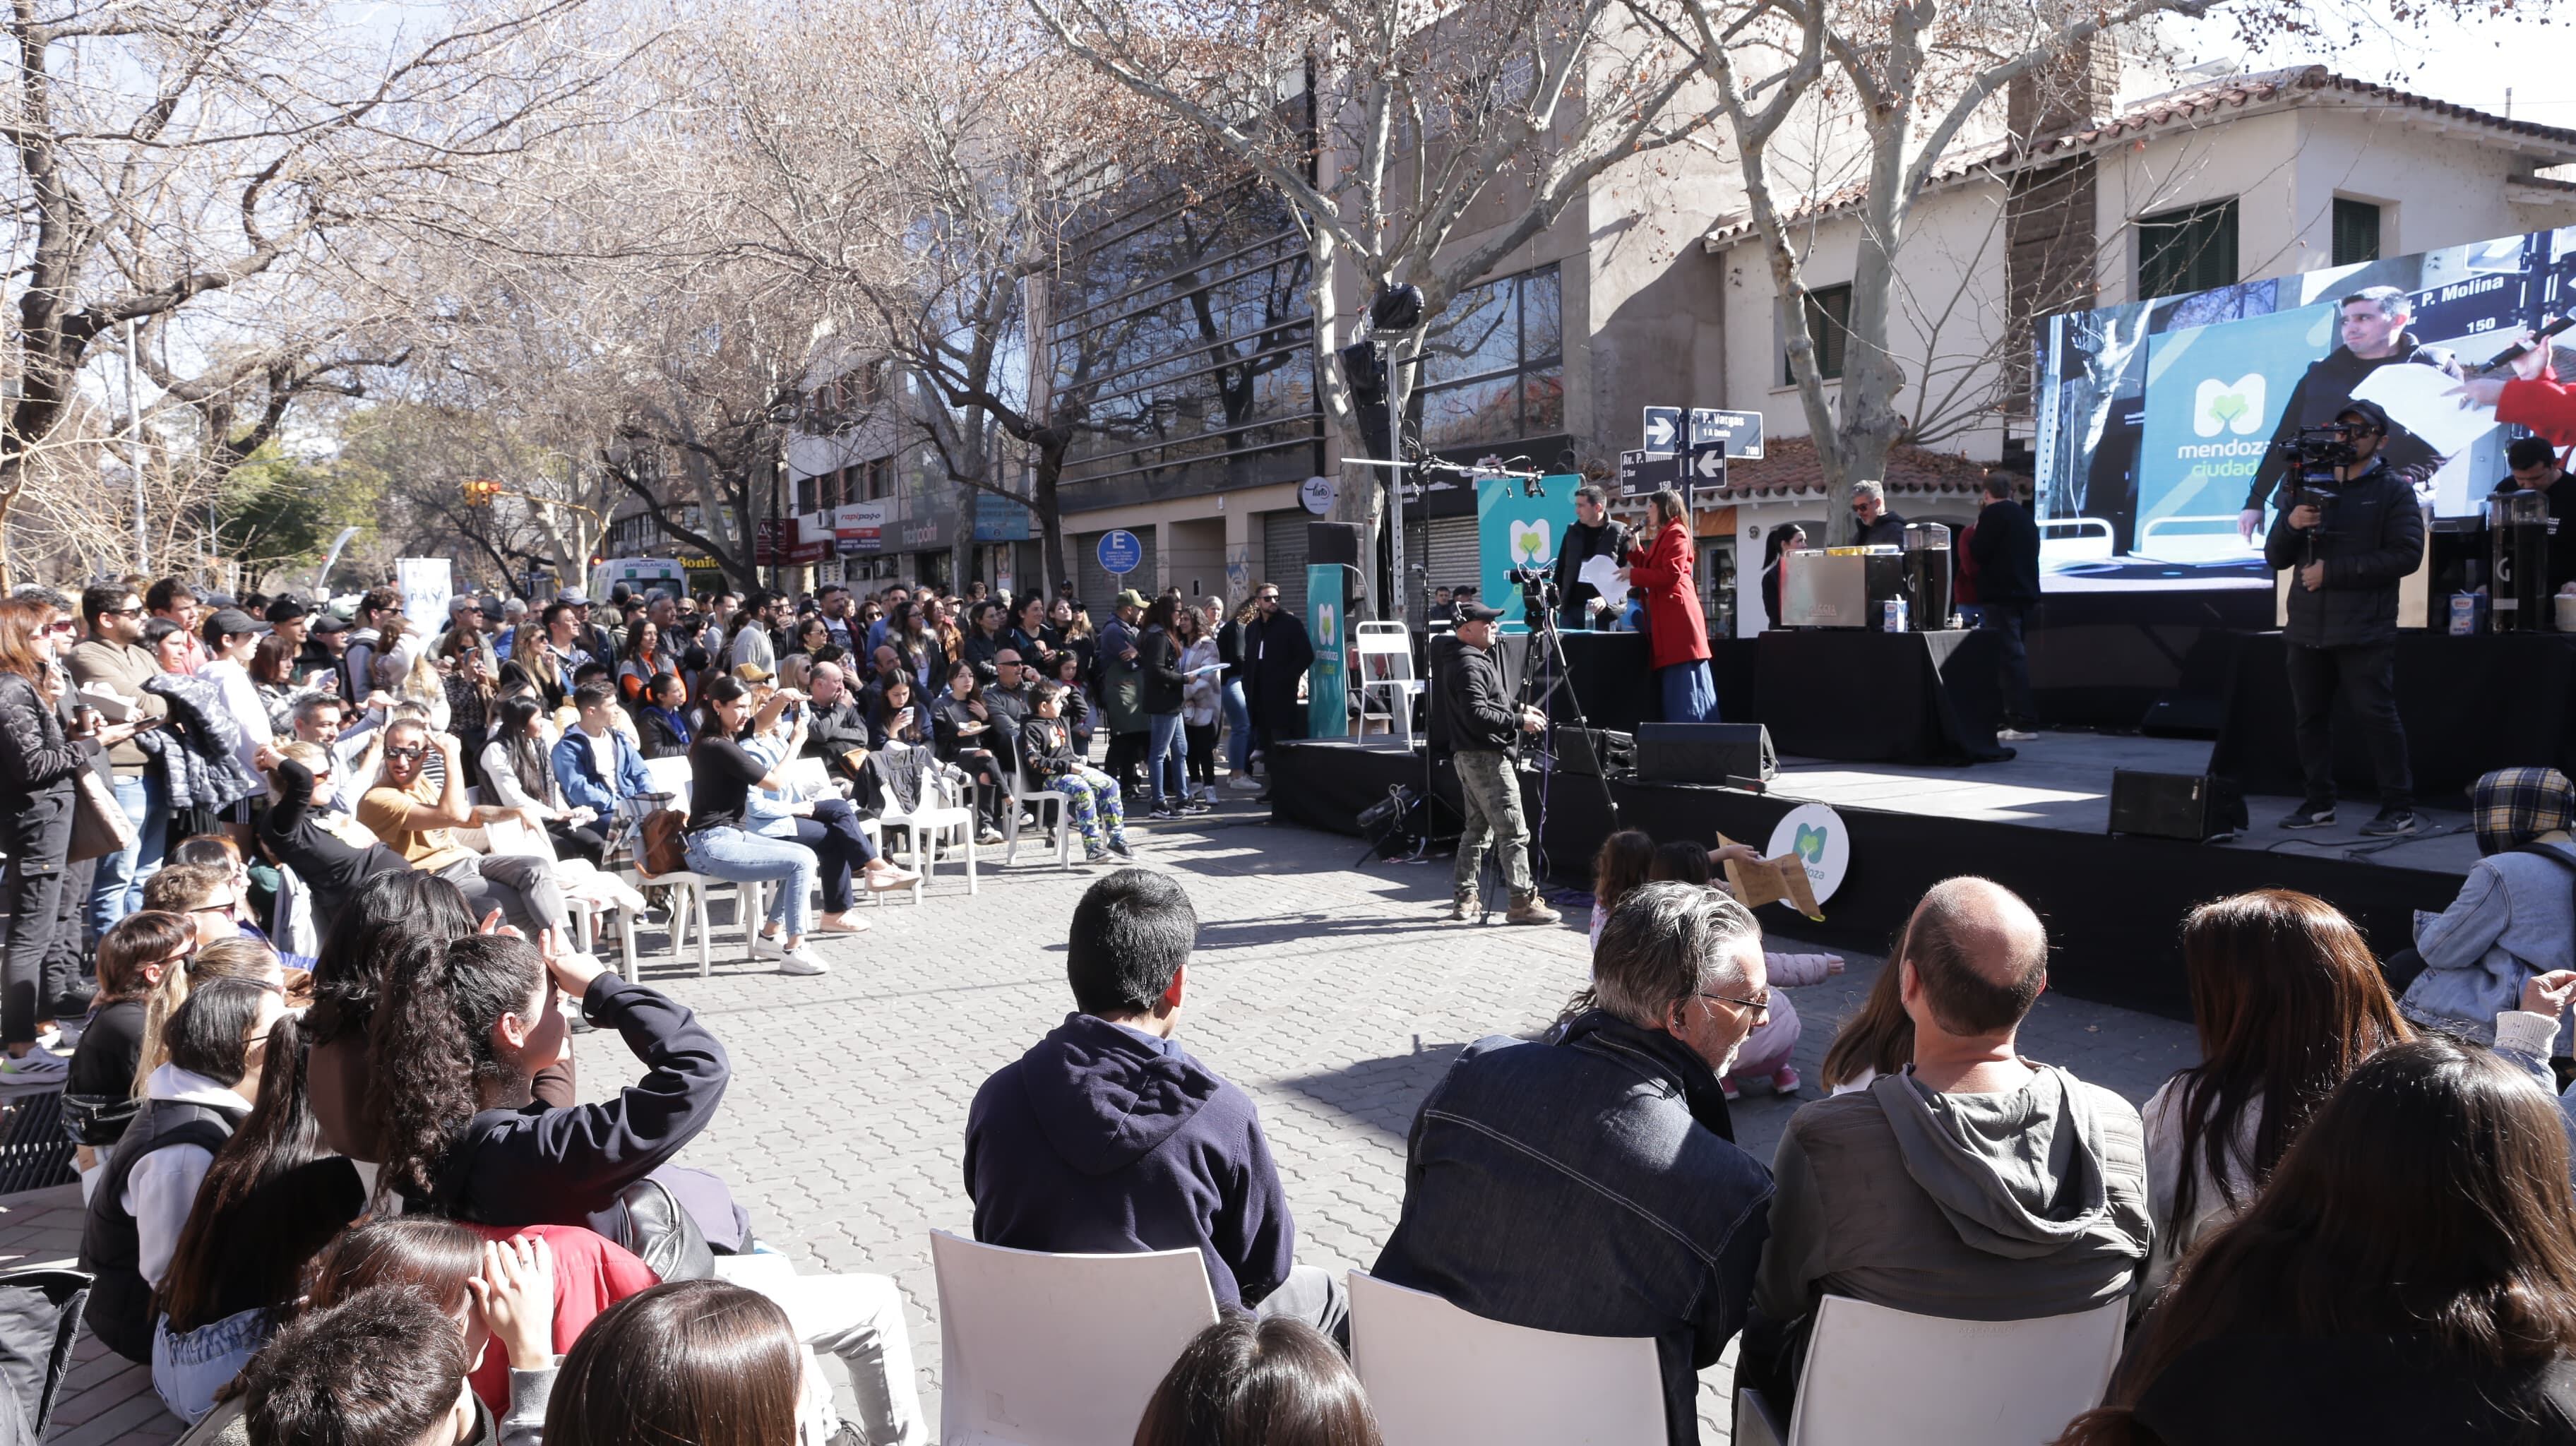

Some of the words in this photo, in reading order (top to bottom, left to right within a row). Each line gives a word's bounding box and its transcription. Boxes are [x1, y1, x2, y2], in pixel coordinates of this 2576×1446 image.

[2422, 291, 2435, 307] P.
[2441, 276, 2504, 302] Molina
[2467, 316, 2496, 334] 150
[1703, 412, 1712, 424] P.
[1714, 413, 1745, 427] Vargas
[1745, 446, 1760, 455] 700
[1623, 454, 1634, 465] Av.
[1636, 453, 1644, 463] P.
[1623, 484, 1635, 494] 200
[1659, 481, 1672, 491] 150
[1112, 532, 1126, 549] E
